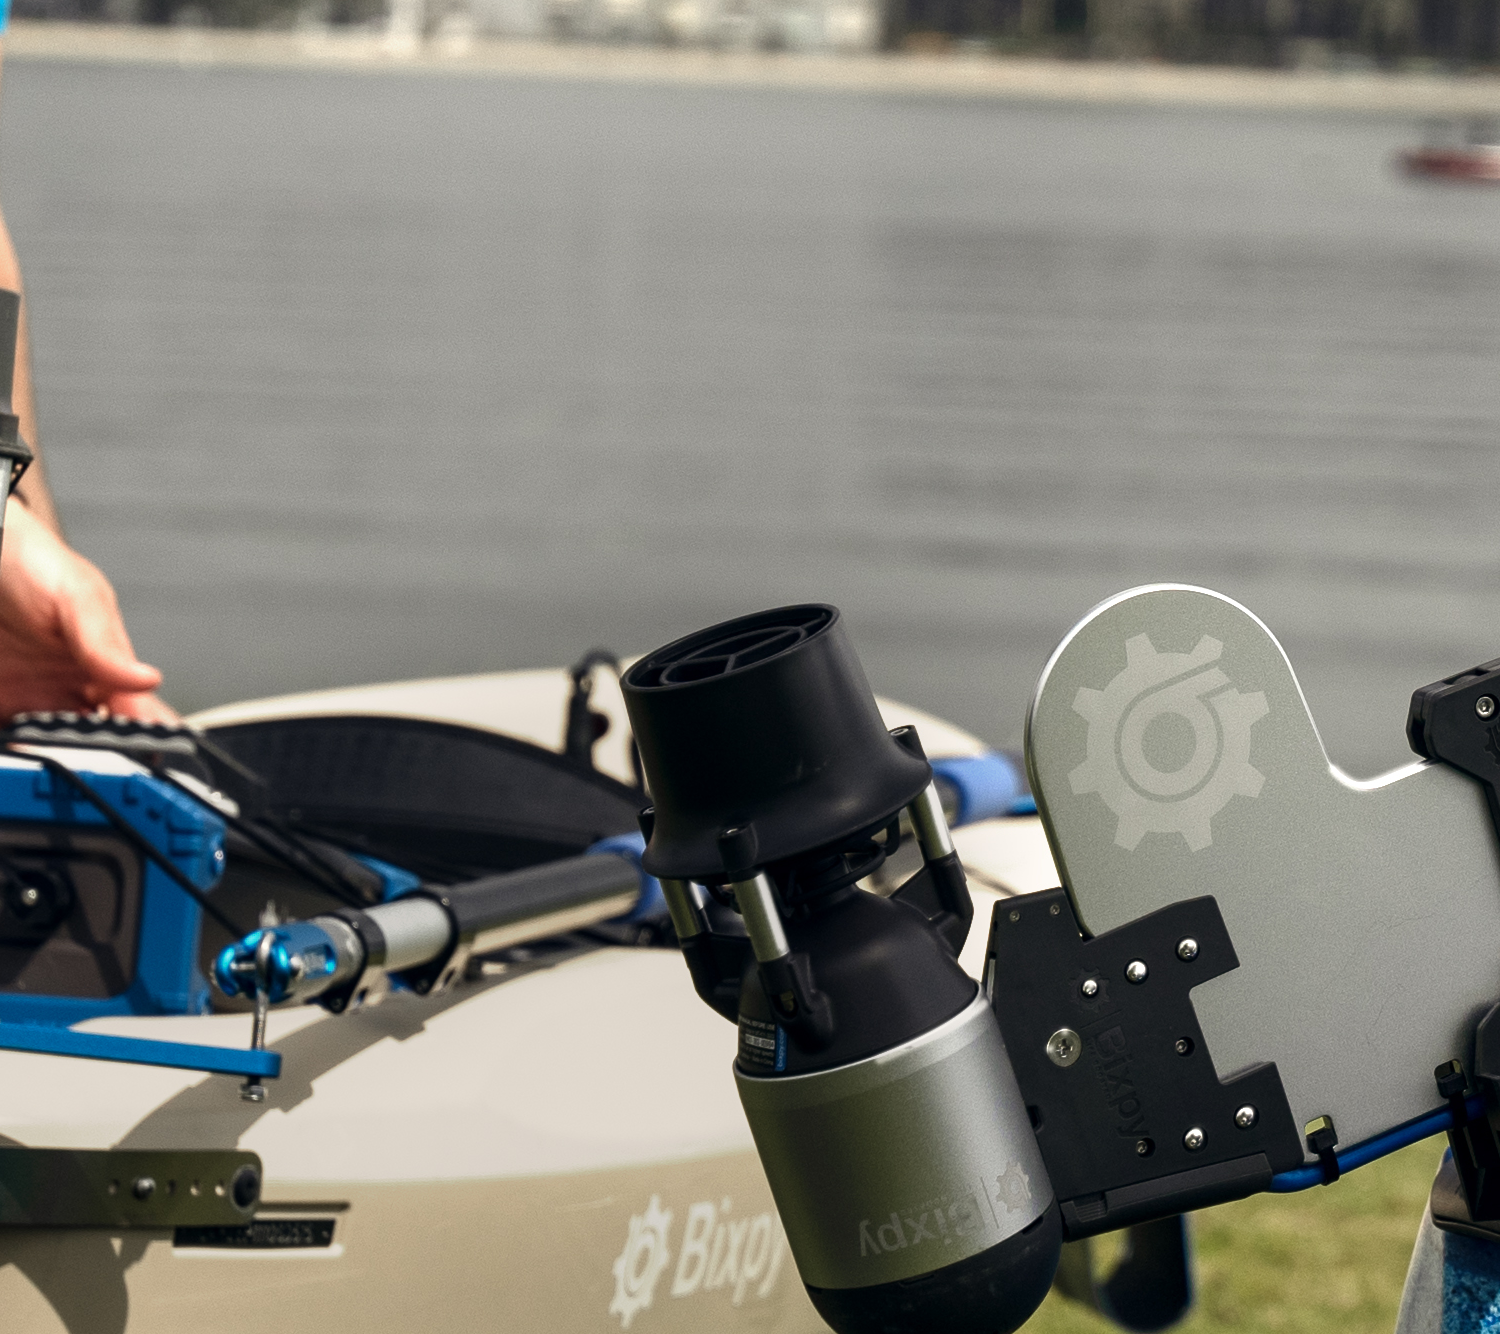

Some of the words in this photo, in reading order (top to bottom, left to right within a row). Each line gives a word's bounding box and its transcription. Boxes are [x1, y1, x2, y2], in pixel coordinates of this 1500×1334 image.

[1091, 1022, 1152, 1139] Bixpy
[670, 1195, 785, 1307] Bixpy
[859, 1197, 980, 1265] Bixpy
